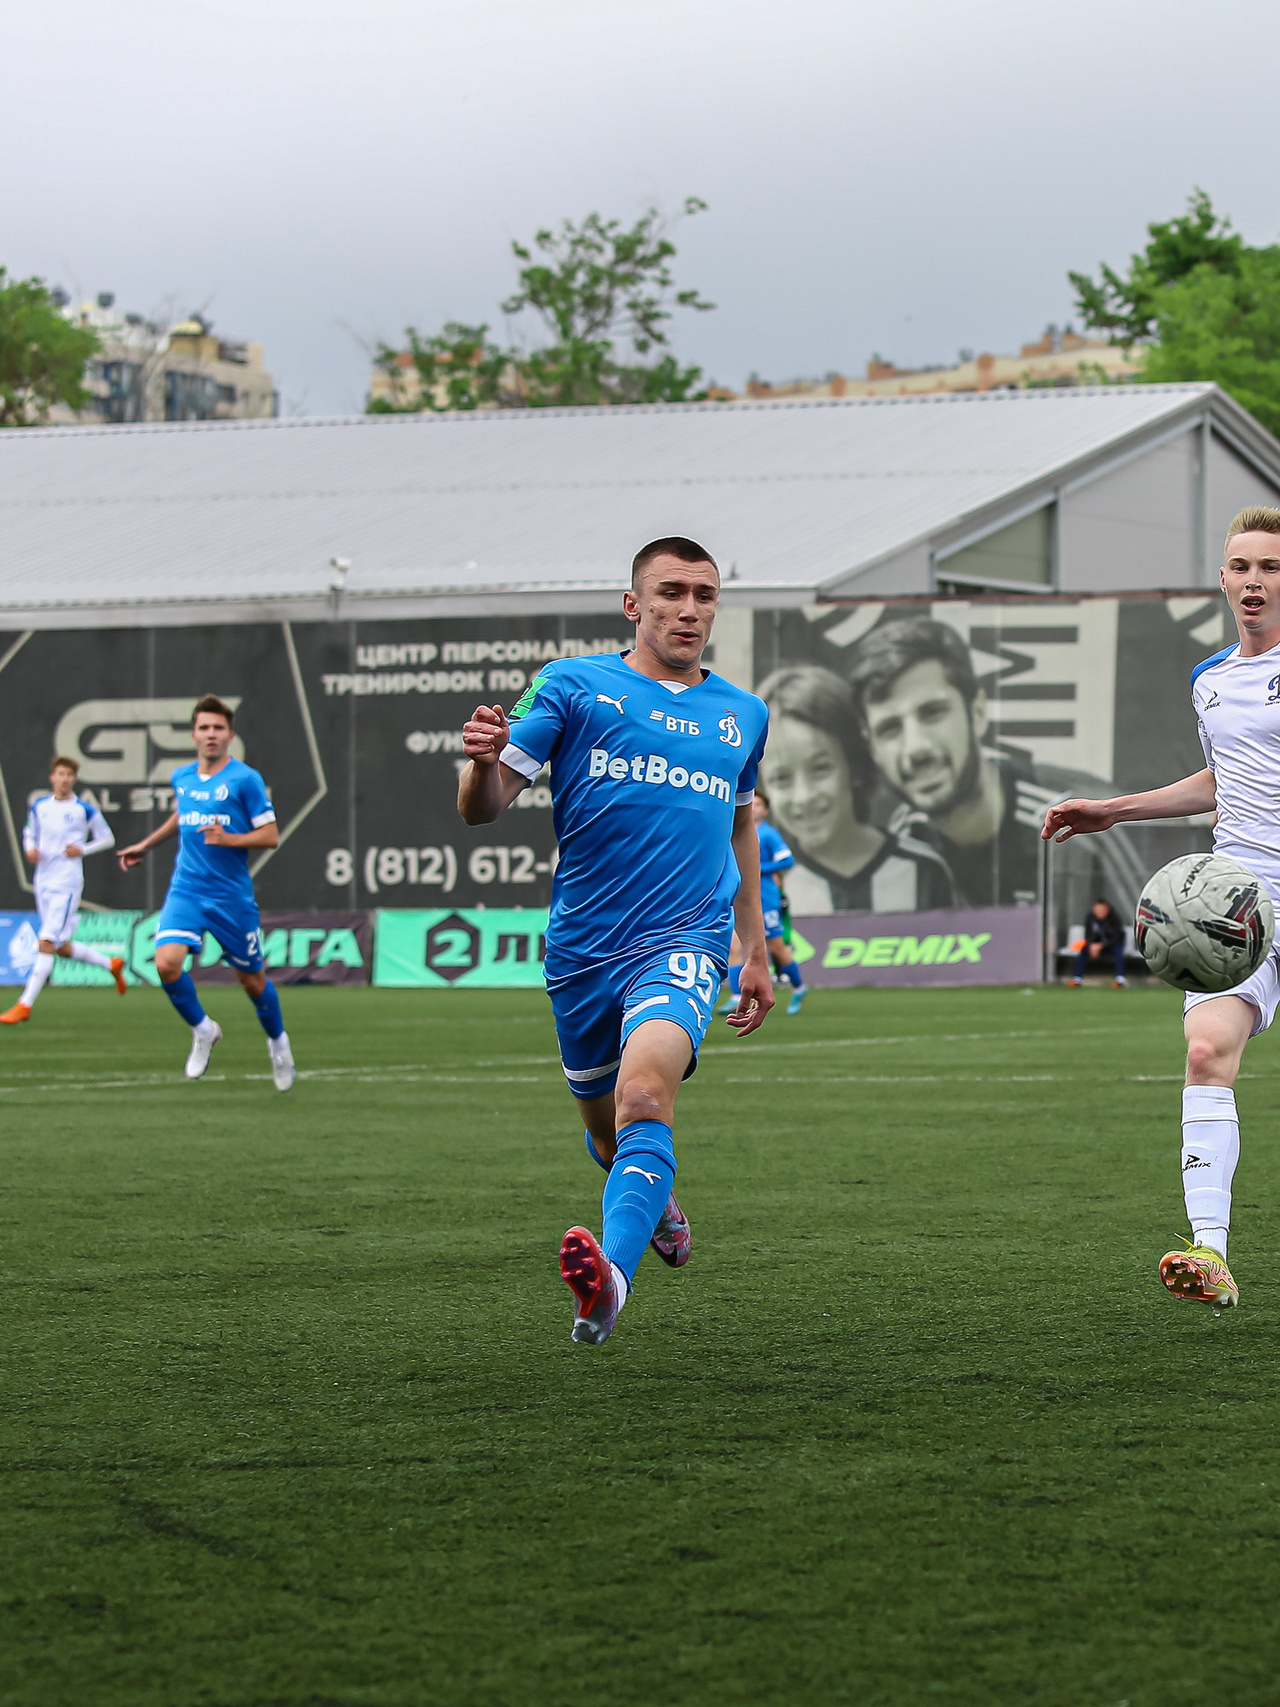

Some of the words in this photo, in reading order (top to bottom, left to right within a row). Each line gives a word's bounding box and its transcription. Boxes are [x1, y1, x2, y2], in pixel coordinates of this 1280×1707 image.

[357, 644, 436, 669] ЦЕНТР
[442, 636, 637, 664] ПЕРСОНАЛЬНЫ
[322, 671, 484, 695] ТРЕНИРОВОК
[490, 668, 526, 691] ПО
[665, 716, 701, 737] ВТБ
[588, 747, 732, 804] BetBoom
[326, 848, 353, 886] 8
[364, 845, 458, 893] (812)
[1181, 855, 1215, 898] DEMIX
[431, 928, 473, 967] 2
[821, 932, 992, 969] DEMIX
[668, 952, 716, 1005] 95
